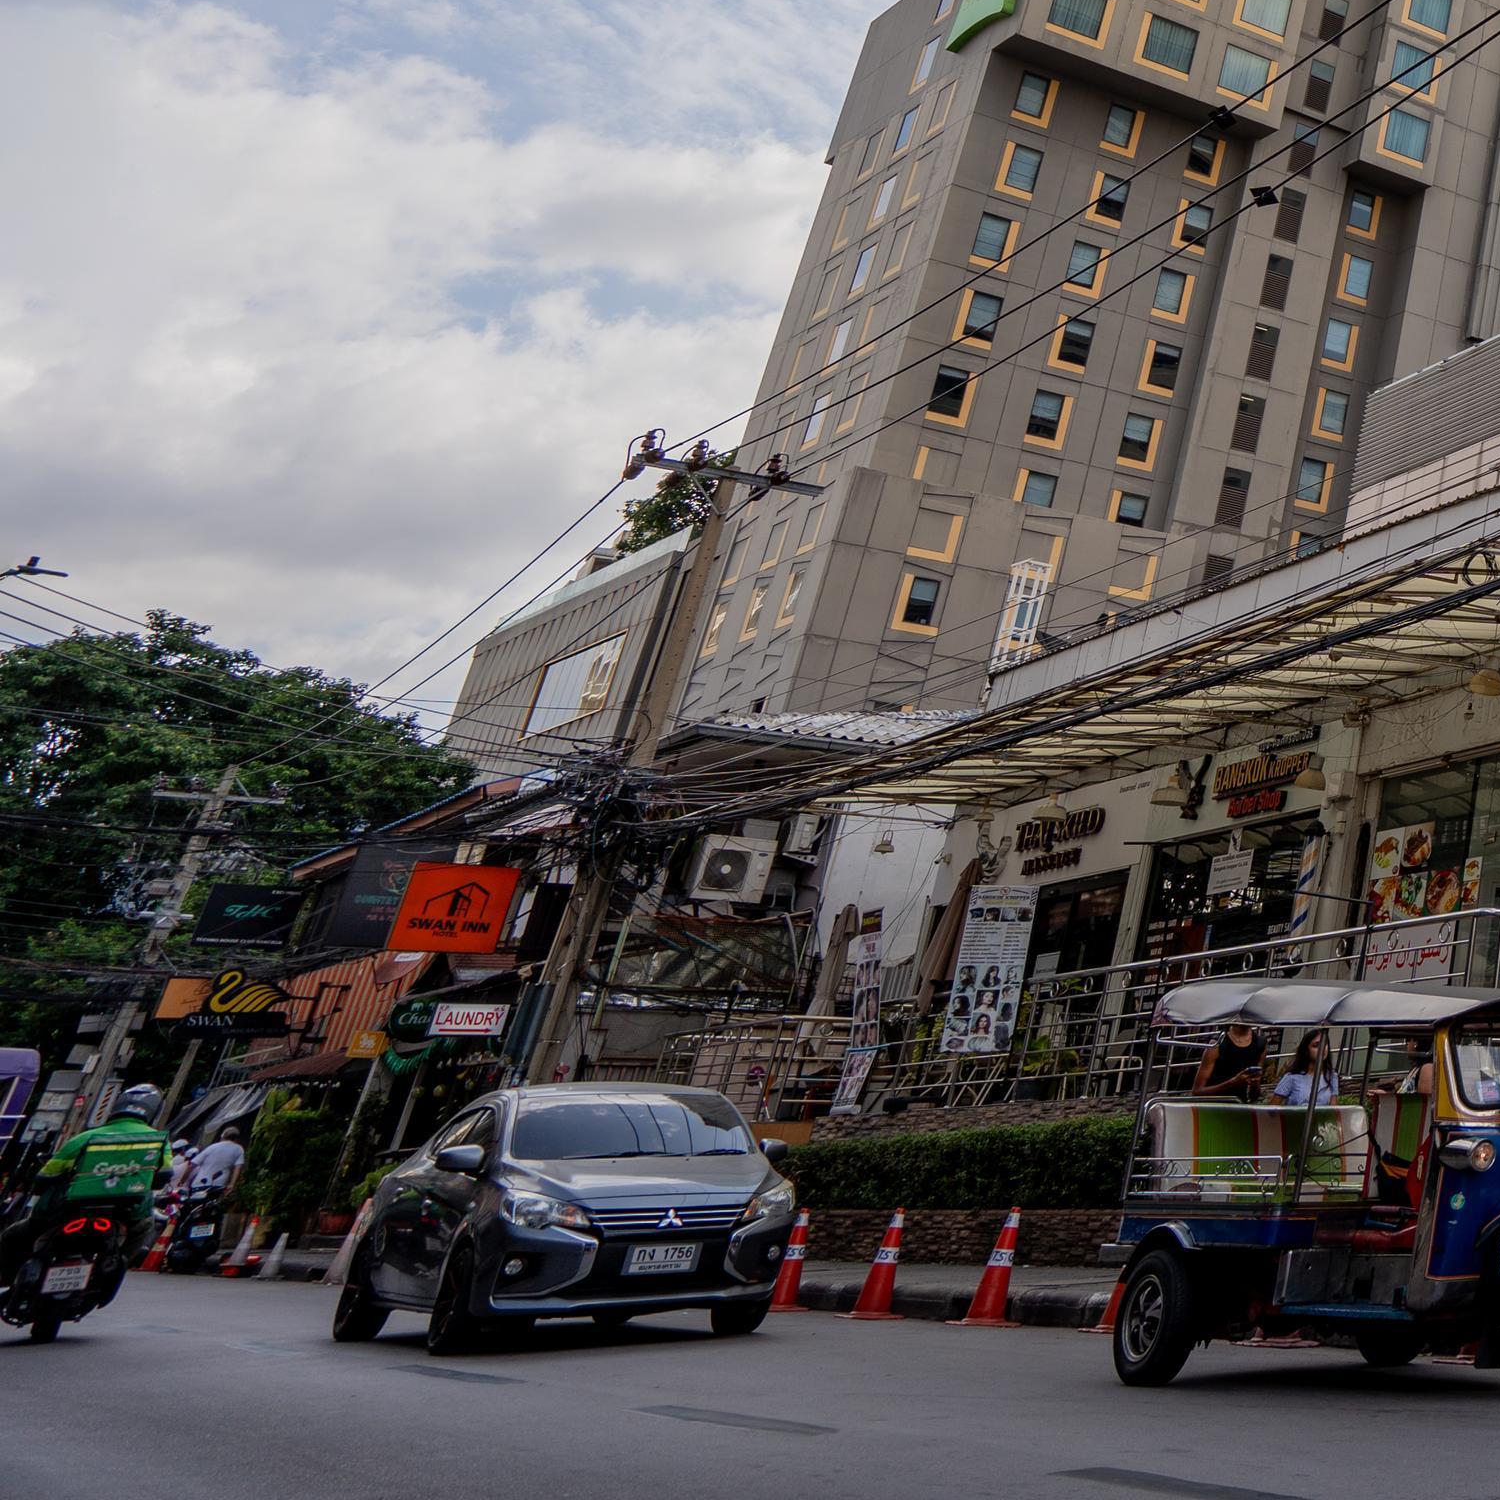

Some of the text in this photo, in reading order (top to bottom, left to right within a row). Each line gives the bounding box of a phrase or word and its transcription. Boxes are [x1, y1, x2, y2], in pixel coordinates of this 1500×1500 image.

[1213, 751, 1311, 794] BANGKOK KROPPER
[407, 917, 458, 931] SWAN
[460, 921, 490, 933] INN
[187, 1015, 236, 1027] SWAN
[398, 1012, 431, 1026] Cha
[435, 1011, 505, 1026] LAUNDRY
[93, 1159, 142, 1177] Grab
[663, 1246, 693, 1260] 1756
